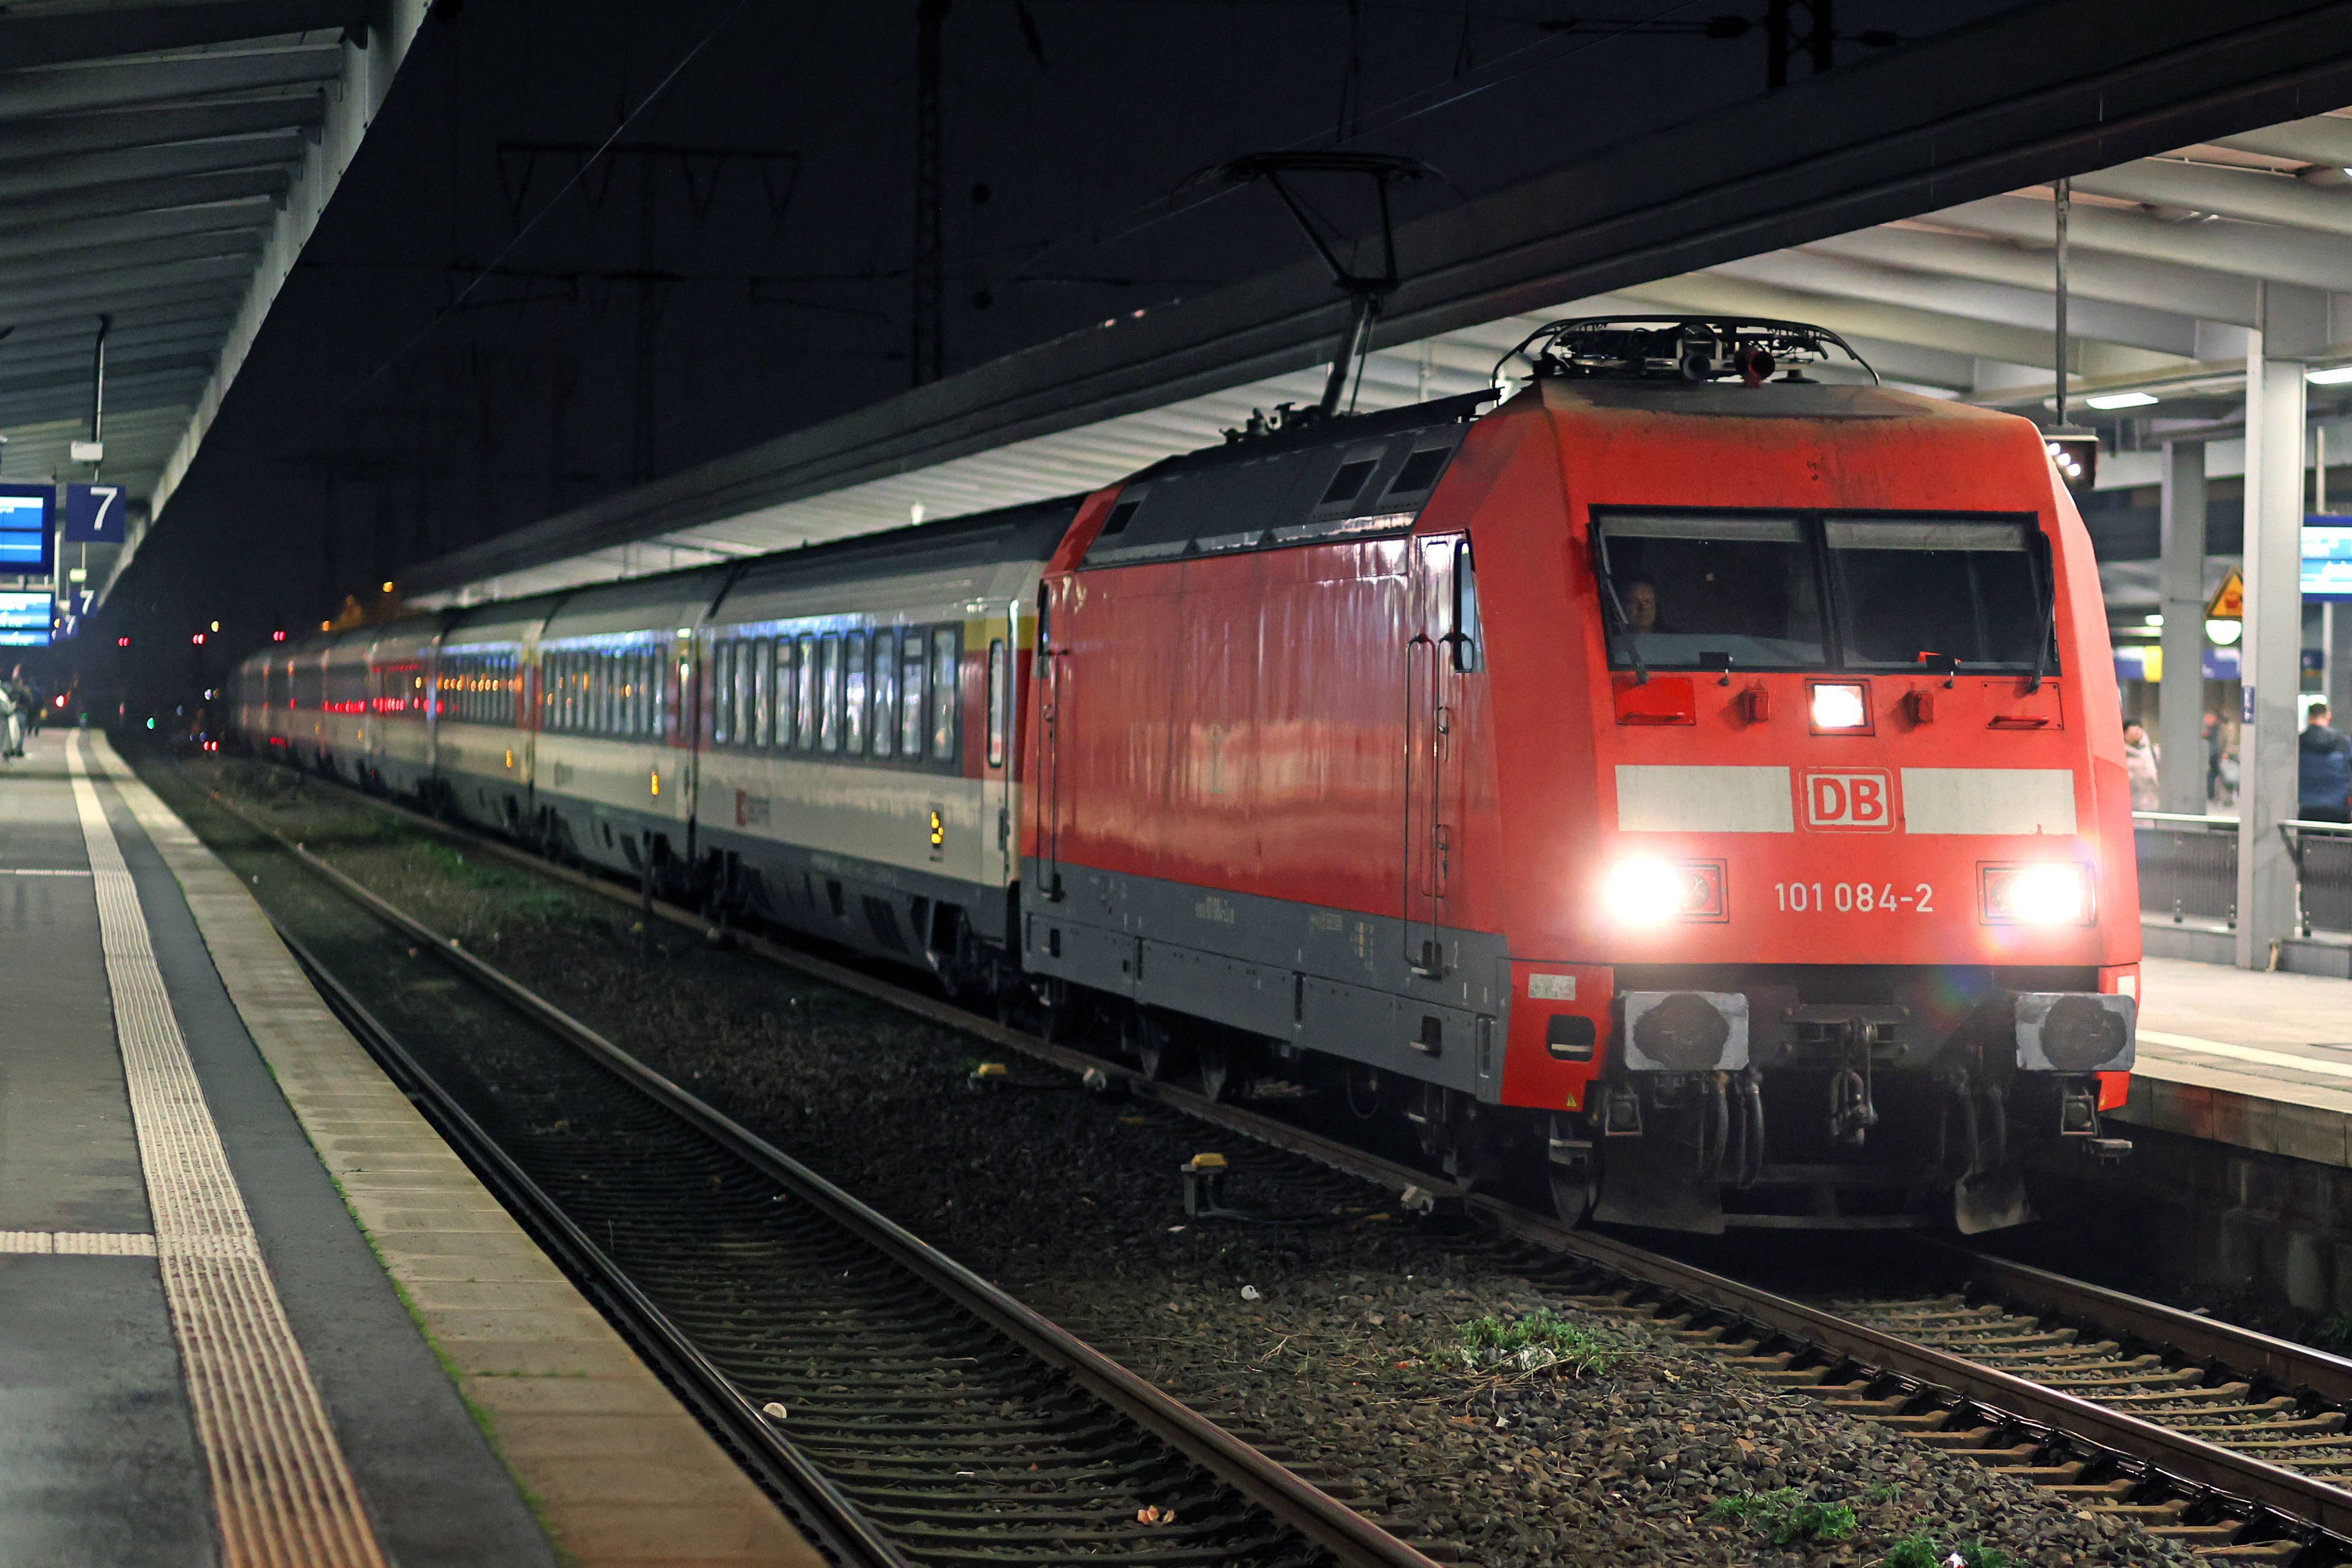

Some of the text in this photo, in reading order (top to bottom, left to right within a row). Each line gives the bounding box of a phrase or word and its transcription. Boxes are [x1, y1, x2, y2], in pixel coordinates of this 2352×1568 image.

[90, 487, 118, 531] 7
[79, 590, 95, 615] 7
[64, 614, 76, 635] 7
[1812, 777, 1883, 821] DB
[1775, 882, 1934, 912] 101 084-2
